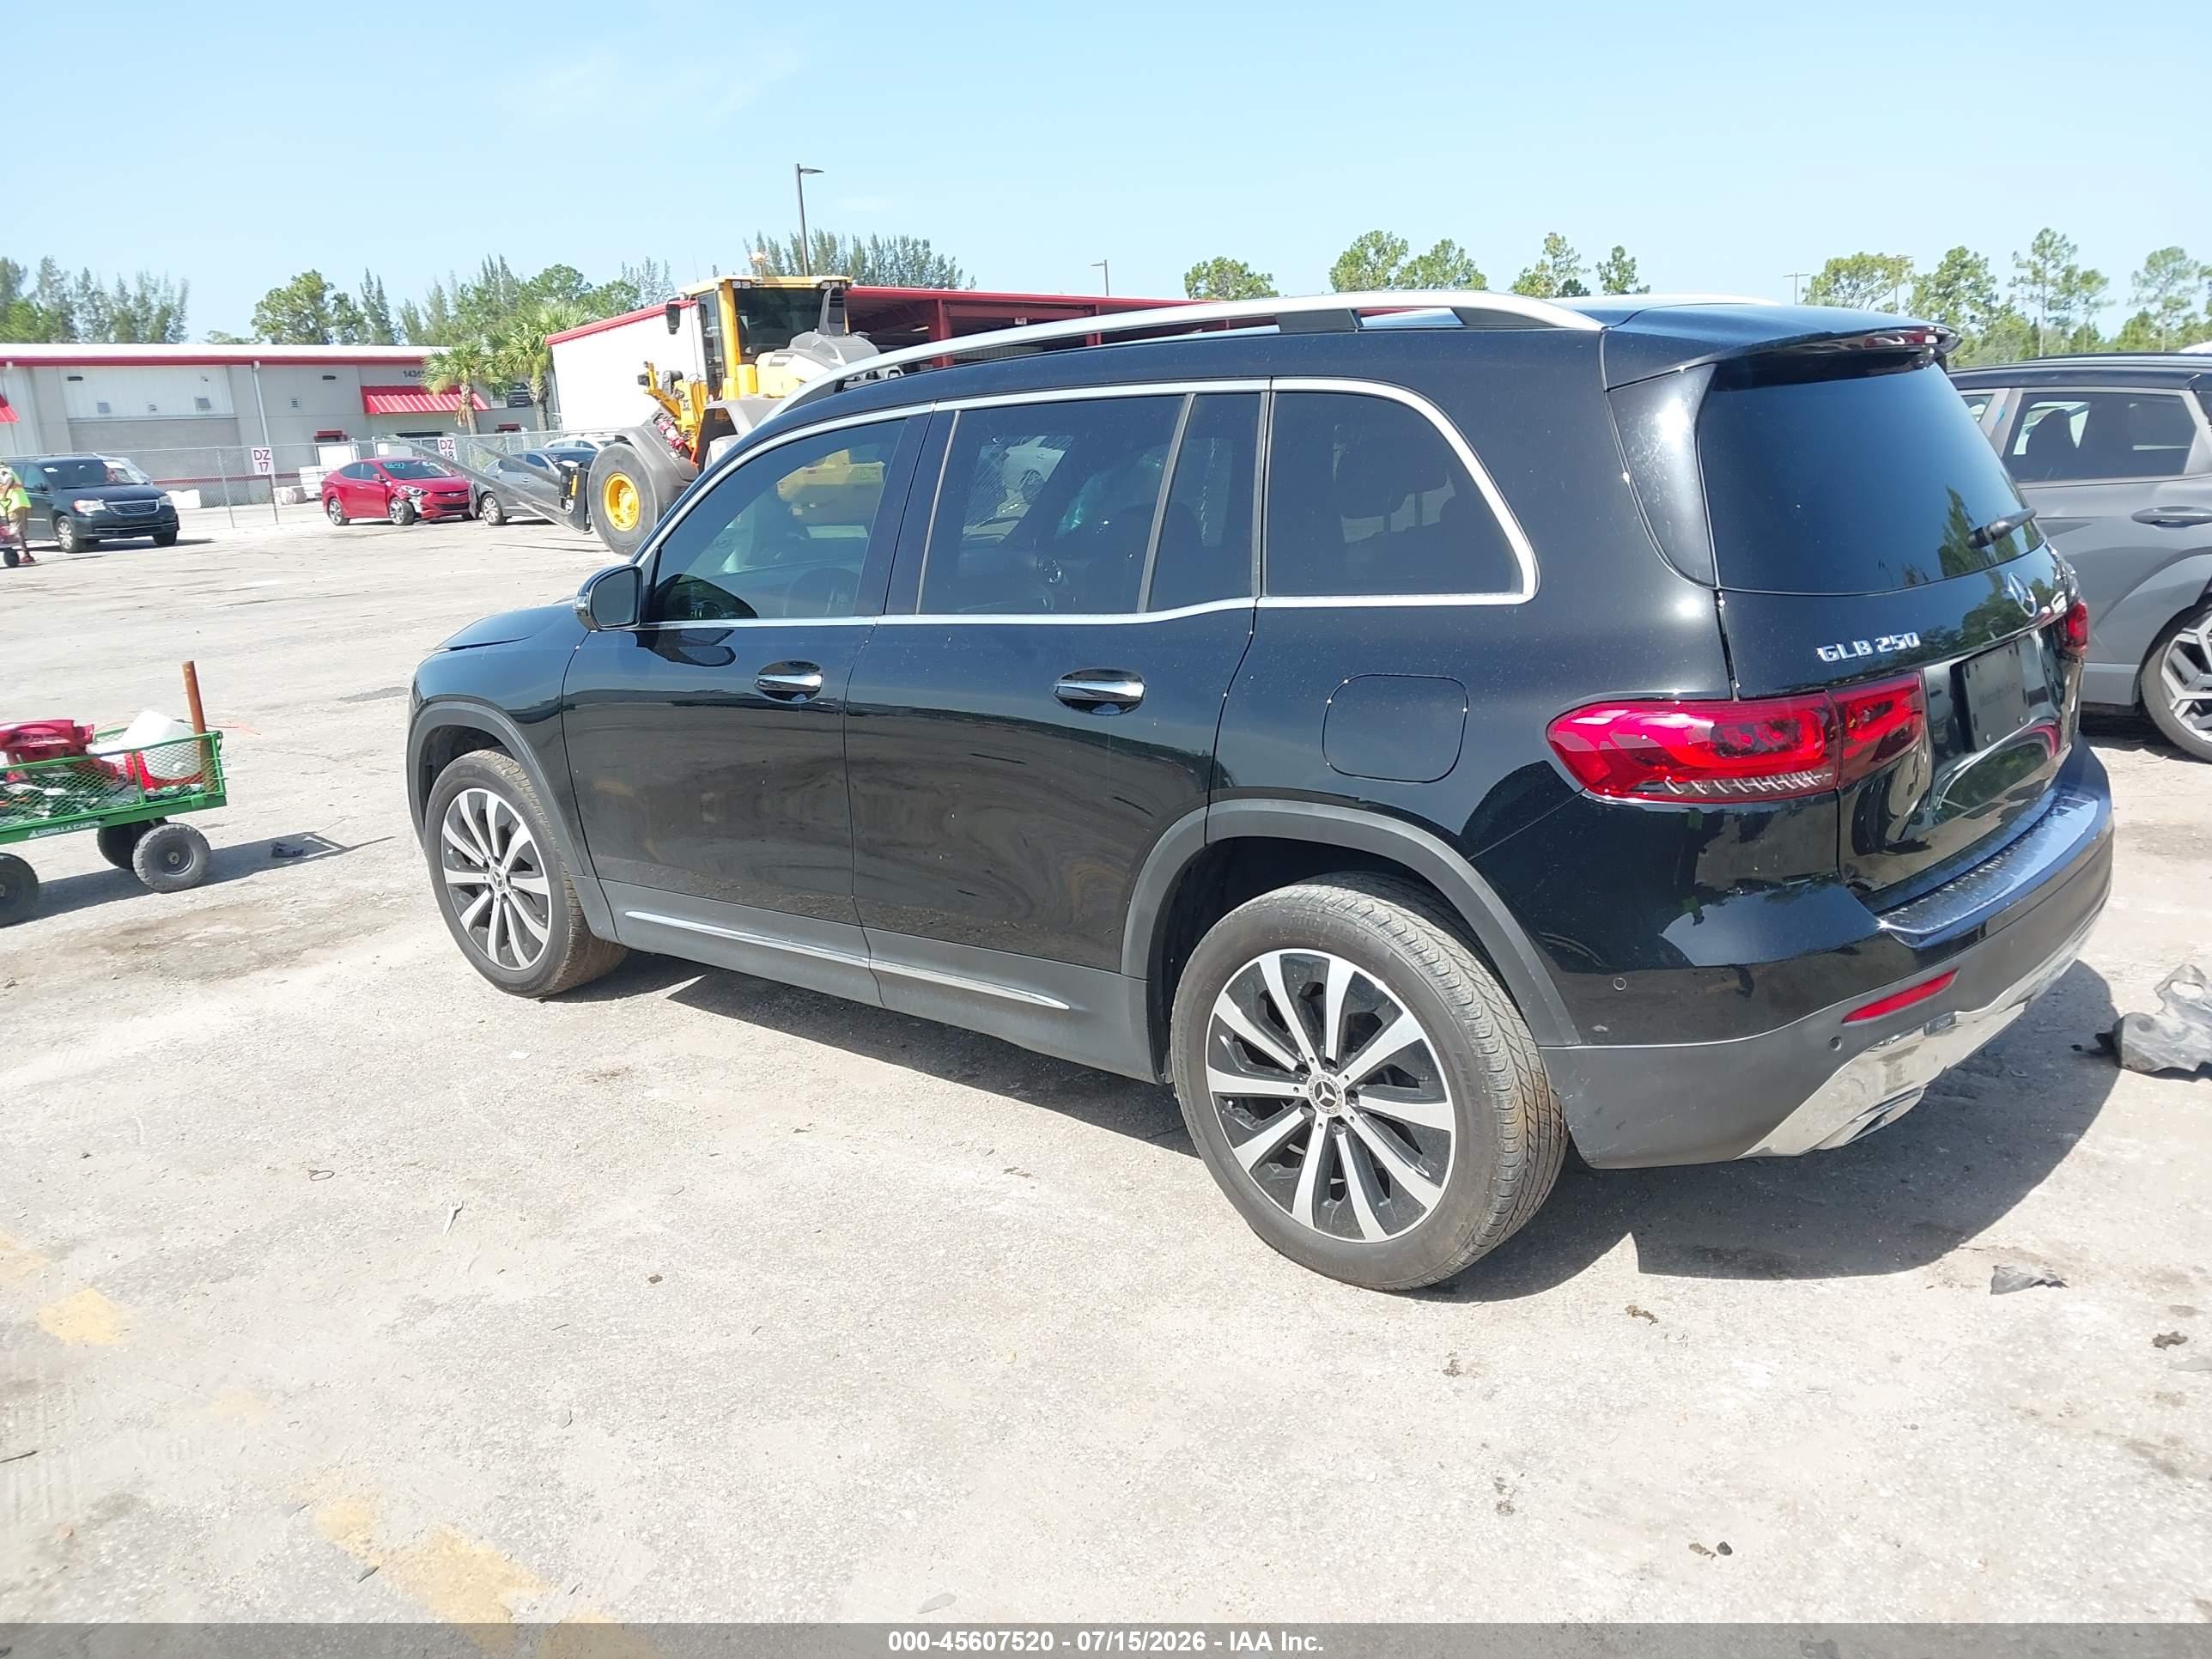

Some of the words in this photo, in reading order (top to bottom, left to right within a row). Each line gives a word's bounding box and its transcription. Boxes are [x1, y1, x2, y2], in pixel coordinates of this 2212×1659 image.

[439, 440, 453, 450] DZ
[254, 449, 270, 460] DZ
[259, 461, 269, 472] 17
[1817, 640, 1874, 662] GLB
[1875, 632, 1921, 653] 250
